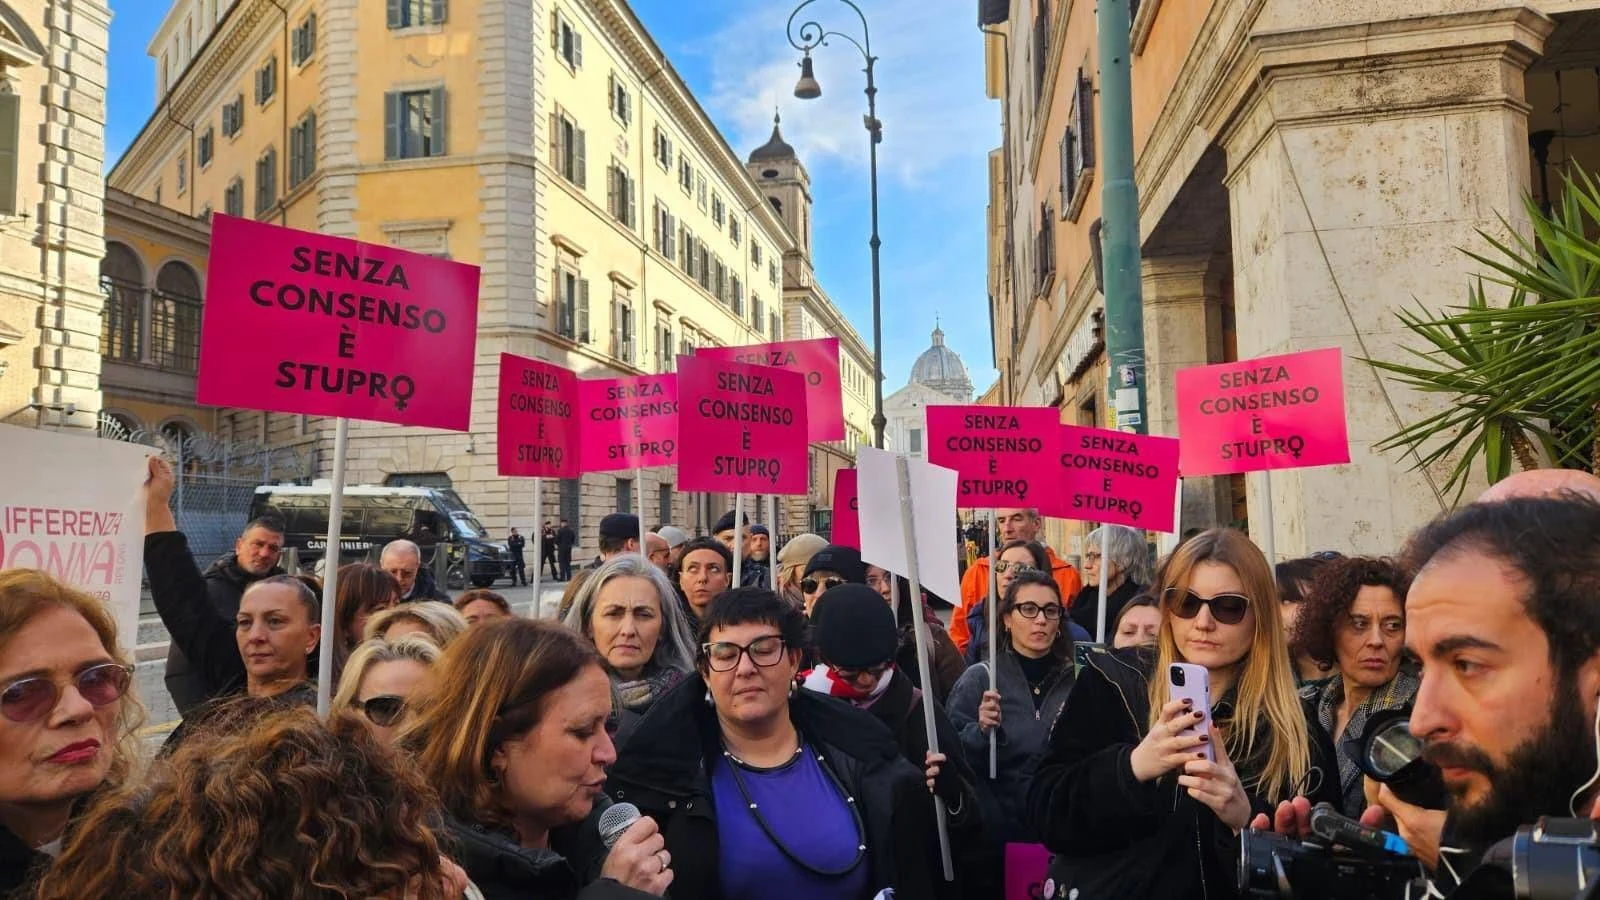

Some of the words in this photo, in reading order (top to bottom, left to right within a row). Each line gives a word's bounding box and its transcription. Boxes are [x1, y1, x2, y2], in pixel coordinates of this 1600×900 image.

[290, 246, 409, 290] SENZA
[250, 280, 446, 333] CONSENSO
[338, 324, 356, 358] È
[736, 350, 796, 367] SENZA
[522, 369, 560, 392] SENZA
[717, 371, 774, 396] SENZA
[1220, 366, 1290, 389] SENZA
[607, 382, 663, 401] SENZA
[1200, 386, 1319, 415] CONSENSO
[510, 394, 571, 419] CONSENSO
[698, 398, 794, 426] CONSENSO
[537, 418, 544, 440] È
[965, 414, 1020, 430] SENZA
[1252, 413, 1262, 434] È
[742, 425, 751, 450] È
[946, 436, 1042, 453] CONSENSO
[1081, 435, 1139, 455] SENZA
[989, 455, 997, 474] È
[1060, 453, 1159, 480] CONSENSO
[1103, 474, 1112, 492] È
[0, 538, 116, 585] ONNA
